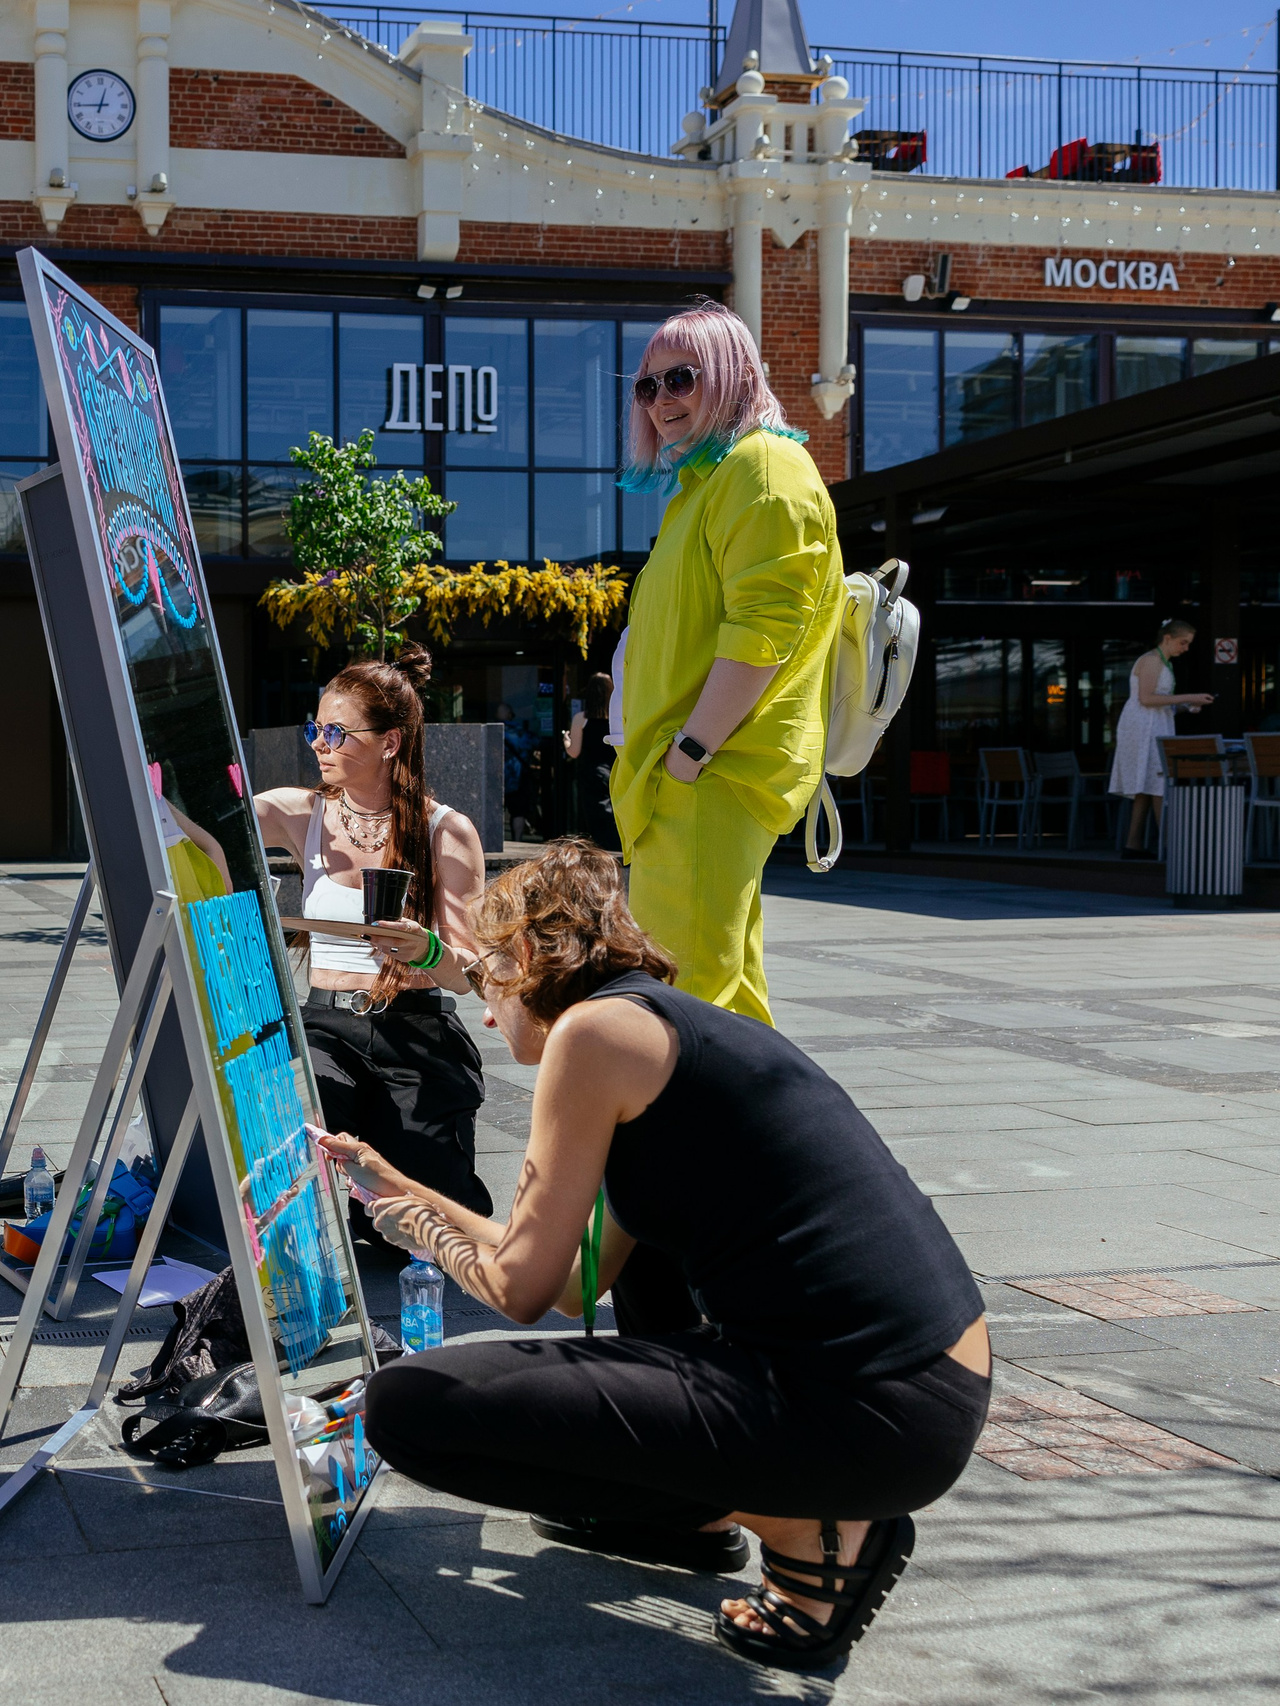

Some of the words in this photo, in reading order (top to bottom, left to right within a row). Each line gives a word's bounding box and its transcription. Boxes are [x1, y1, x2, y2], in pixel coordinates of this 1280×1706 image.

[1044, 257, 1180, 292] МОСКВА
[385, 363, 498, 432] ДЕПО
[1047, 685, 1065, 695] WC
